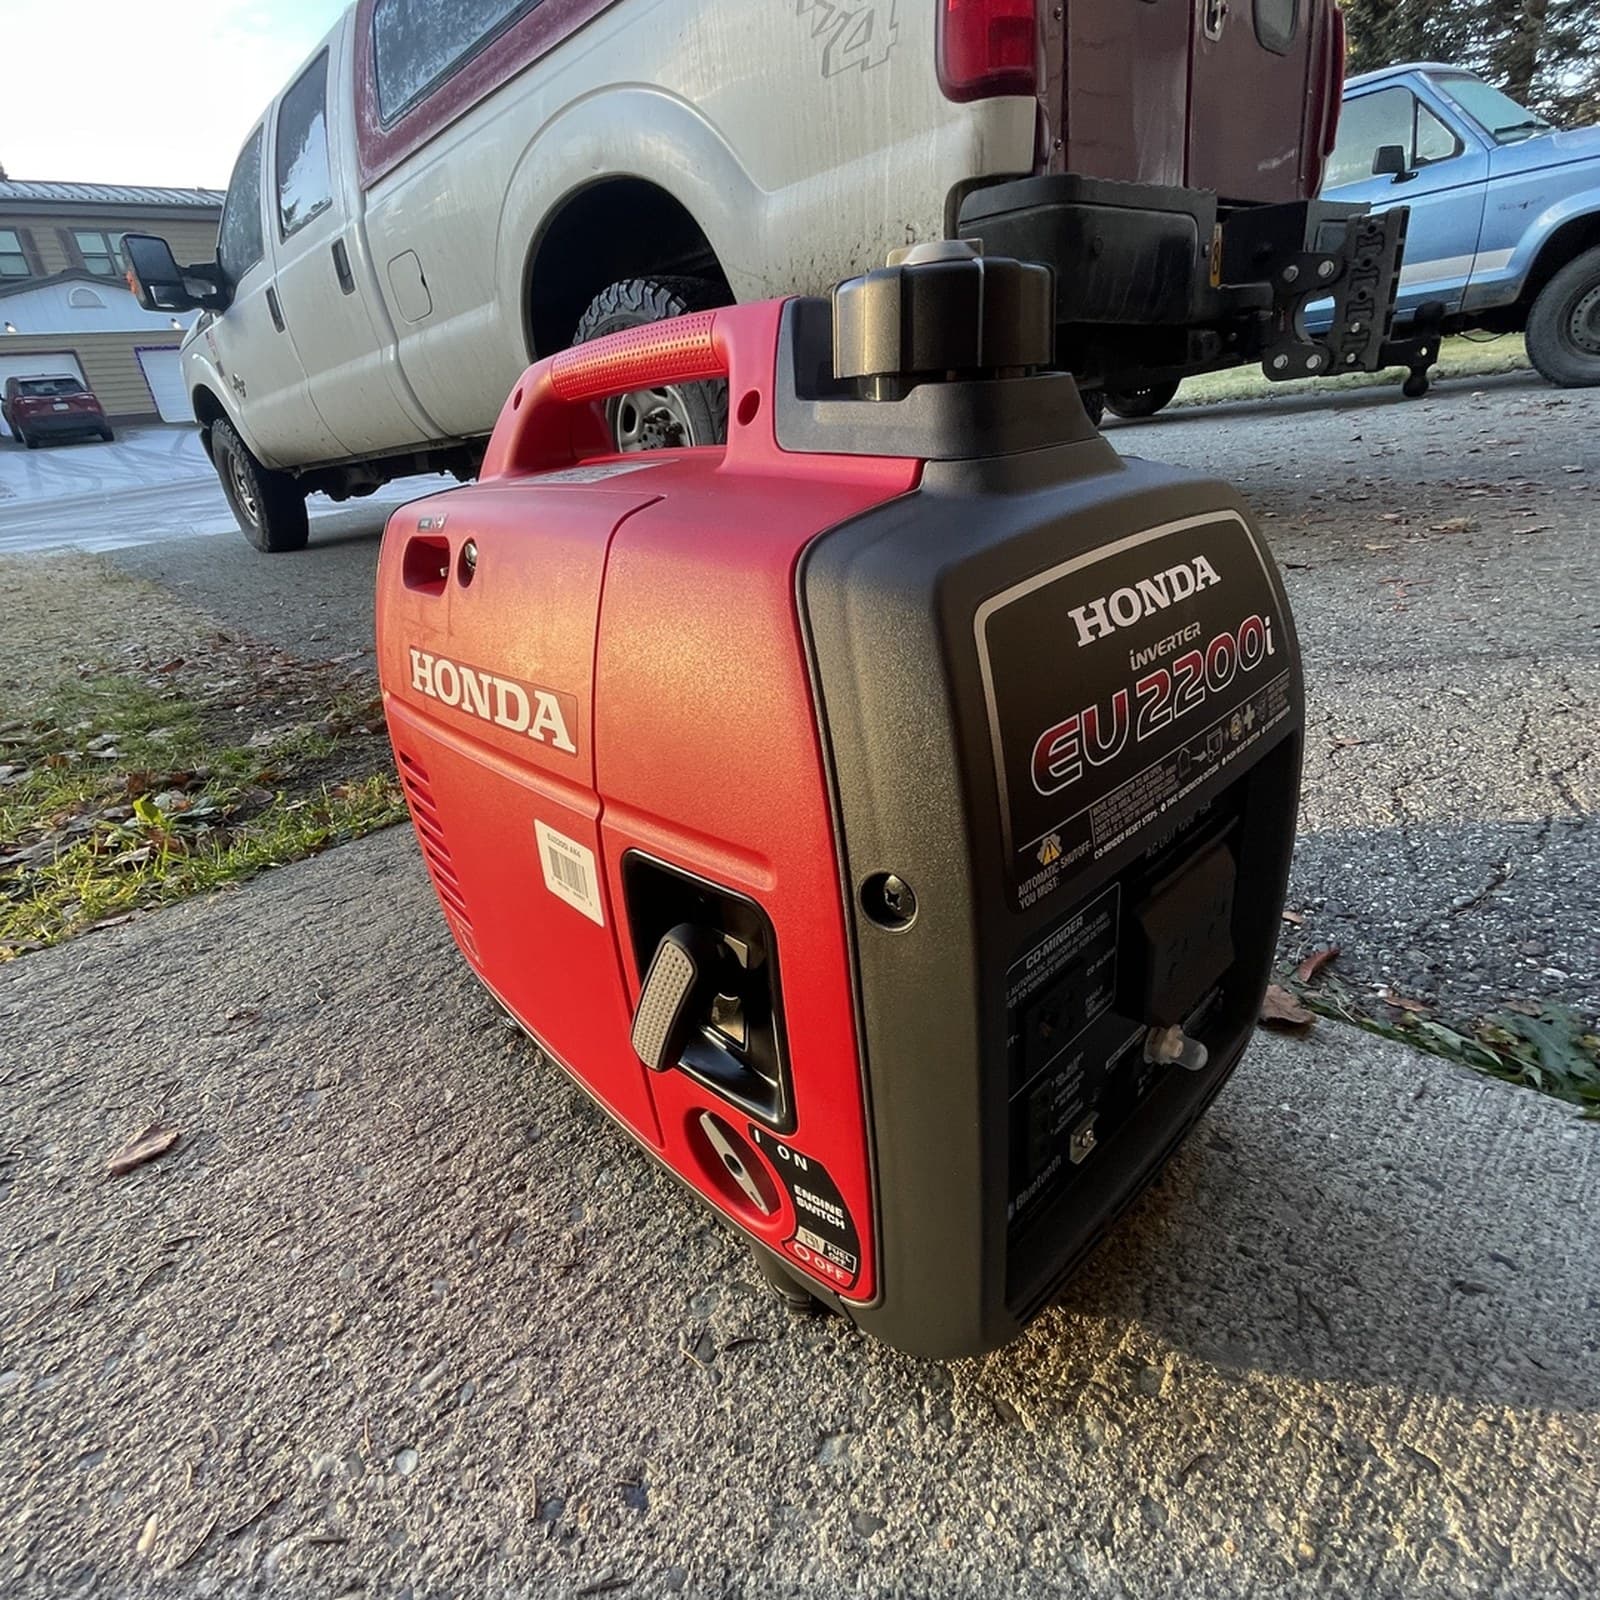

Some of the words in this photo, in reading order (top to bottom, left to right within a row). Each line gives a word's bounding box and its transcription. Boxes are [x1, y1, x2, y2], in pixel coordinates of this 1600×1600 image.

[1068, 555, 1221, 647] HONDA
[409, 648, 577, 754] HONDA
[1031, 614, 1275, 796] EU2200i
[1018, 861, 1060, 898] AUTOMATIC
[1019, 890, 1036, 909] YOU
[1025, 915, 1083, 969] CO-MINDER
[777, 1144, 808, 1171] ON
[794, 1184, 844, 1218] ENGINE
[795, 1196, 845, 1230] SWITCH
[814, 1257, 844, 1280] OFF
